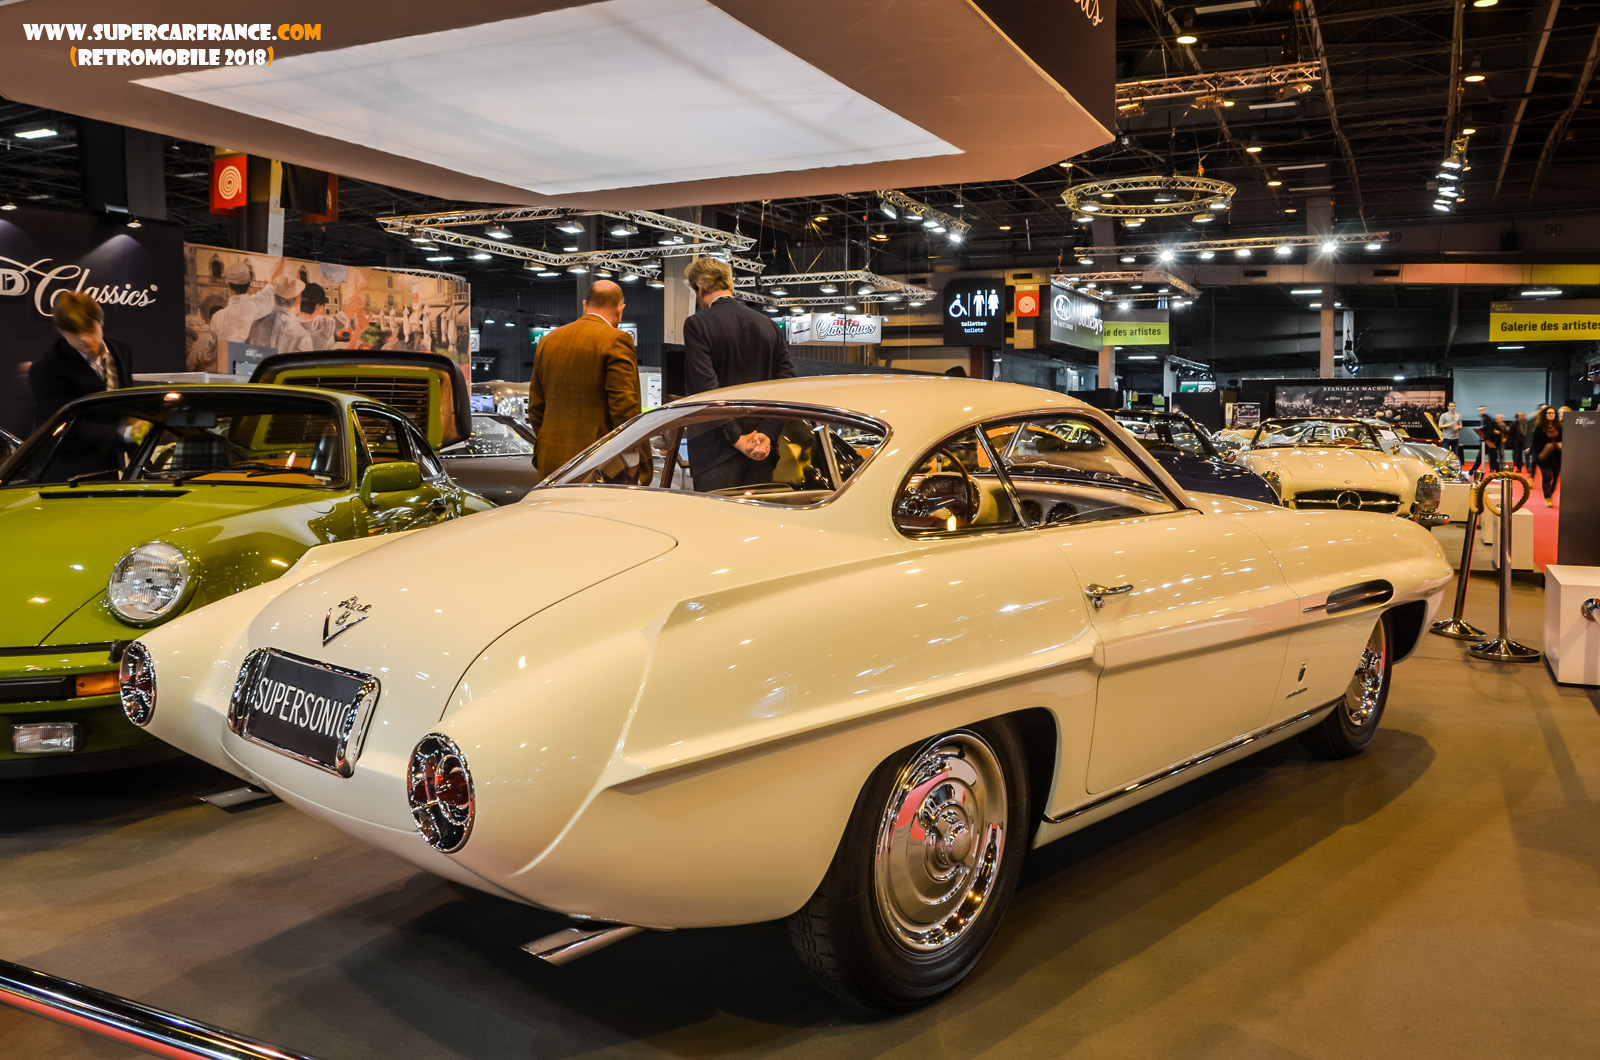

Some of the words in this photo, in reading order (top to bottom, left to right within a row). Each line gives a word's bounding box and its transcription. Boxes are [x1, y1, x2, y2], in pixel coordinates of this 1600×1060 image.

[1545, 223, 1564, 235] 30
[1501, 322, 1538, 332] Galerie
[1540, 321, 1559, 331] des
[1562, 320, 1600, 331] artistes
[1113, 329, 1127, 337] des
[1129, 328, 1161, 336] artistes
